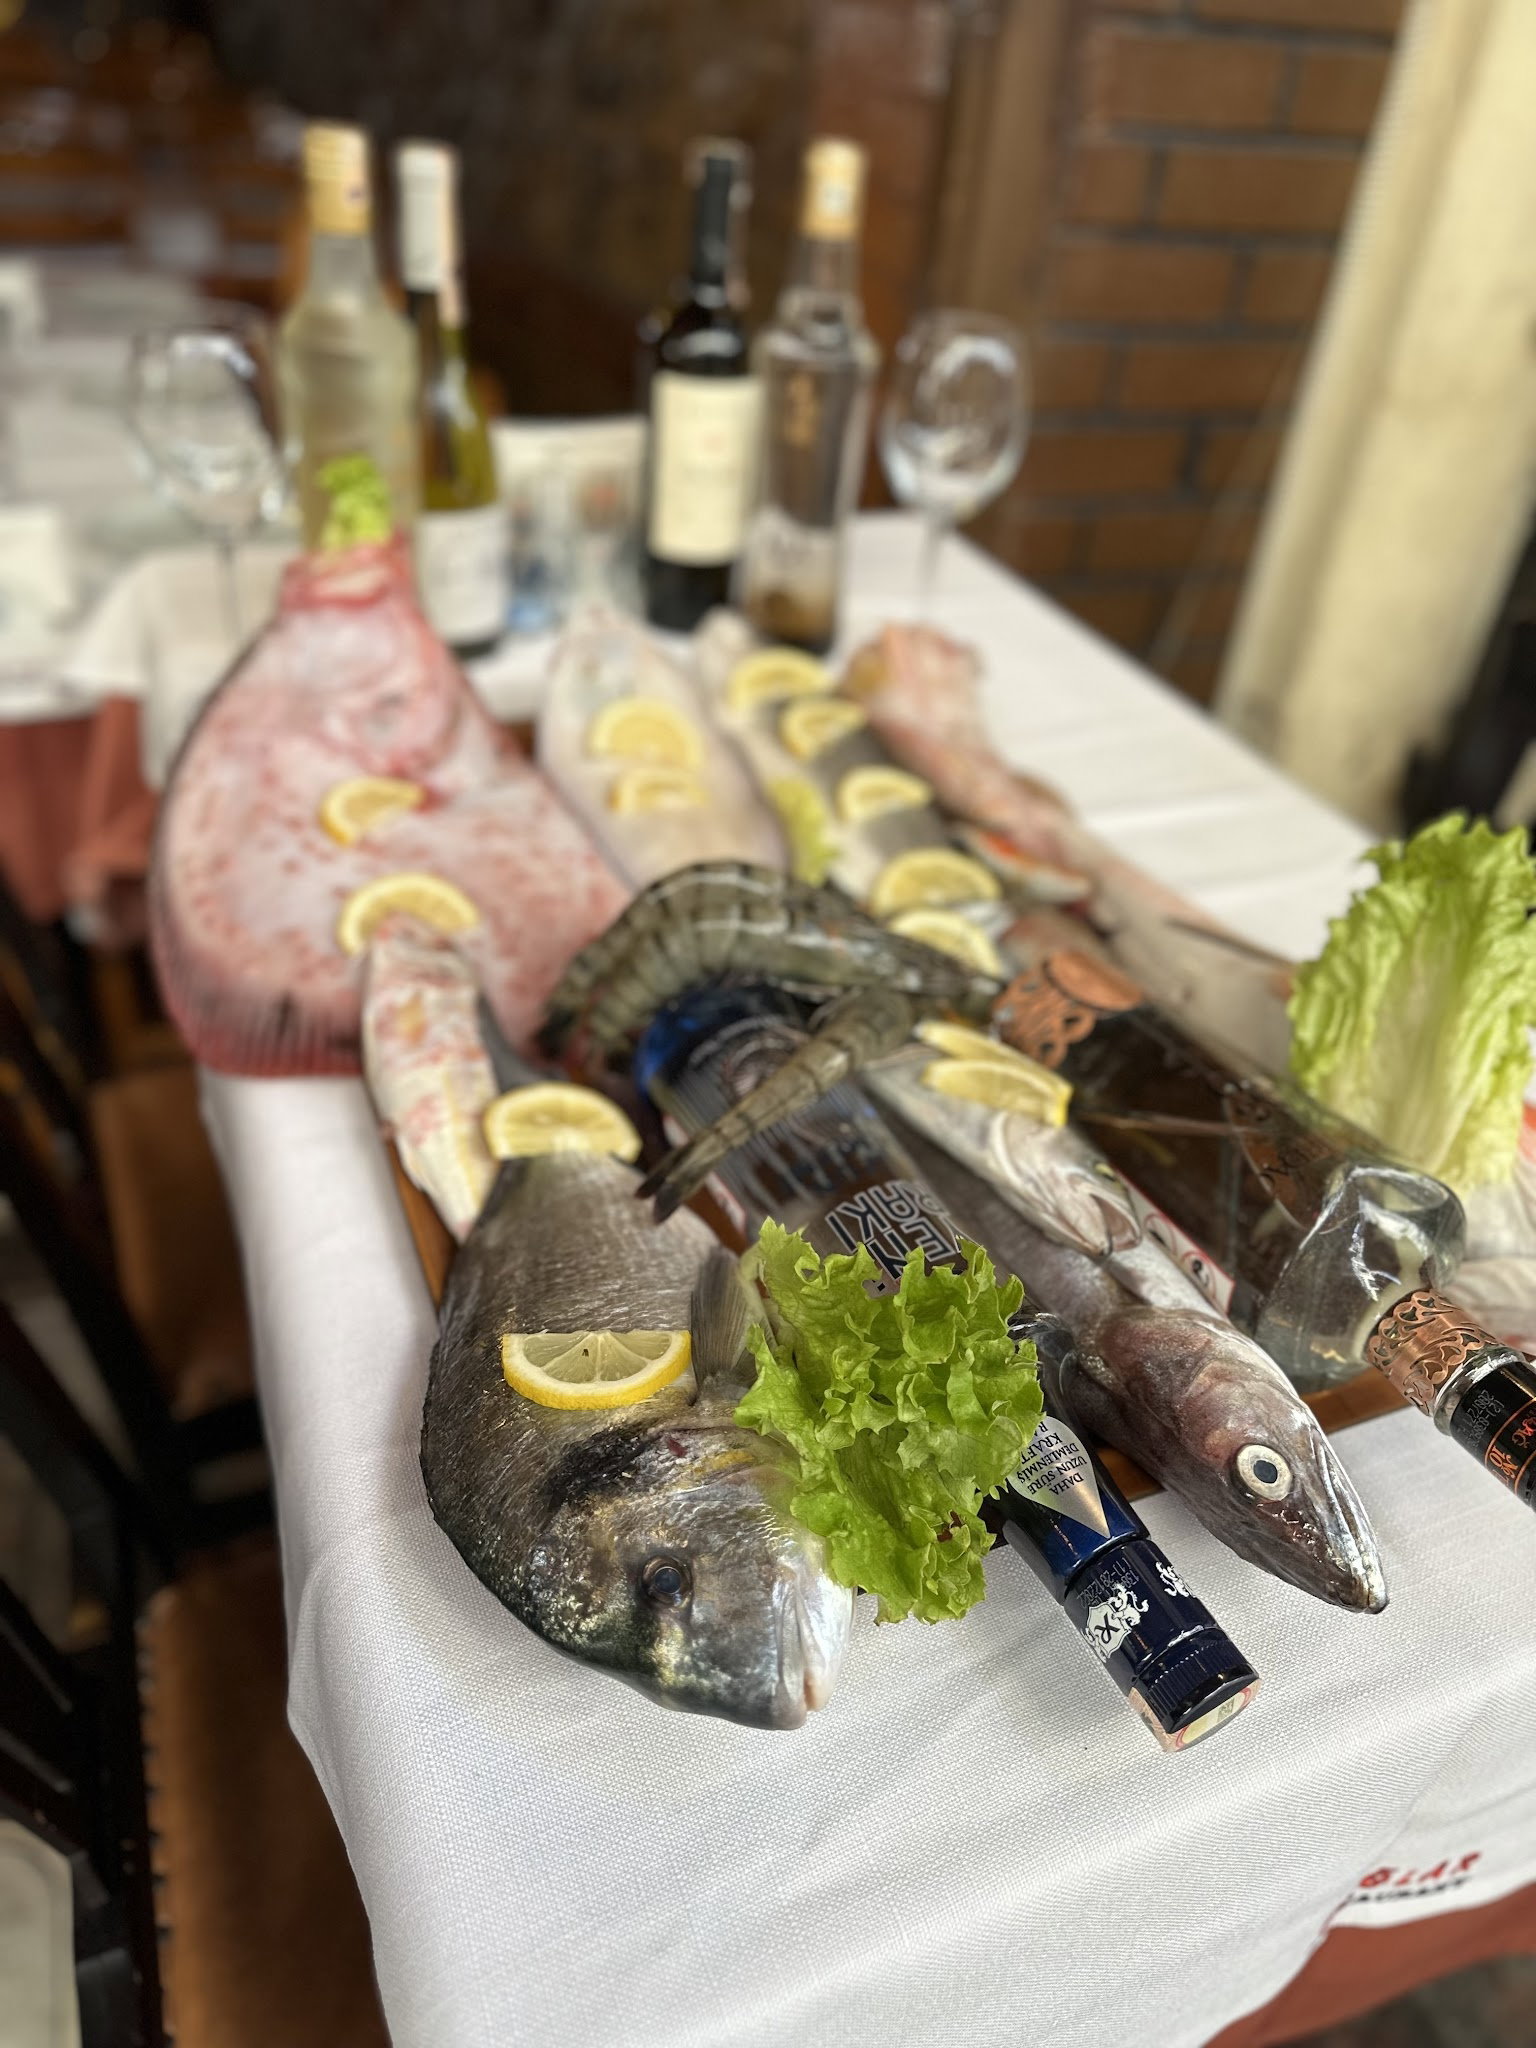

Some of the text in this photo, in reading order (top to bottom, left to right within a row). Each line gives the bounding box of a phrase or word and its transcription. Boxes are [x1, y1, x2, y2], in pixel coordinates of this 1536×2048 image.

[825, 1179, 947, 1254] RAKI
[1016, 1442, 1080, 1484] DEMLENMİŞ
[1020, 1432, 1063, 1465] KRAFT
[1027, 1455, 1087, 1495] UZUN SÜRE
[1049, 1472, 1084, 1495] DAHA
